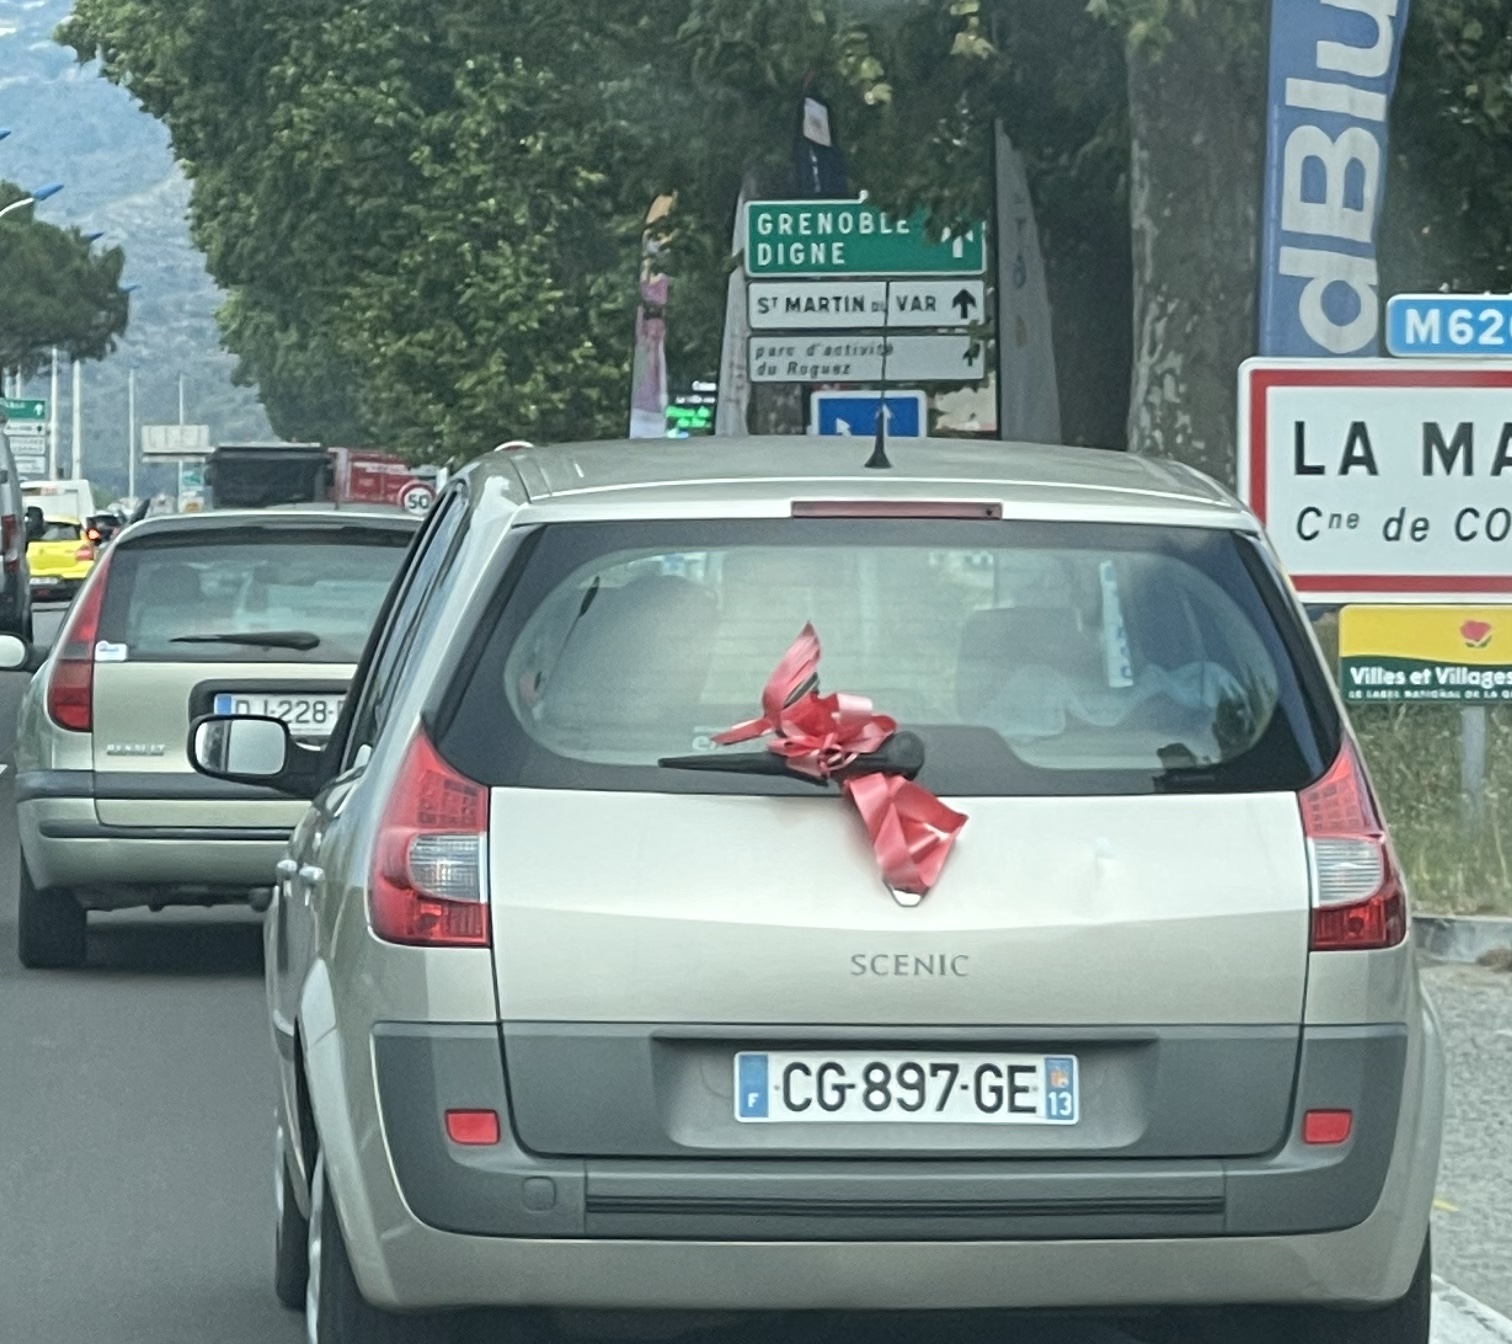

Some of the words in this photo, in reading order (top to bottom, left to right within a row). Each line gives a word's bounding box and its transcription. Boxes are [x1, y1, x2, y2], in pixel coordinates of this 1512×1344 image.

[758, 212, 910, 235] GRENOBLE
[758, 242, 846, 265] DIGNE
[785, 295, 865, 313] MARTIN
[896, 295, 937, 312] VAR
[755, 346, 795, 361] parc
[757, 362, 777, 376] du
[1294, 420, 1379, 477] LA
[409, 494, 431, 510] 50
[1296, 506, 1361, 542] Cne
[1383, 506, 1430, 543] de
[1350, 667, 1406, 685] Villes
[1409, 668, 1432, 685] et
[850, 954, 970, 977] SCENIC
[747, 1093, 759, 1108] F
[782, 1061, 1037, 1114] CG-897-GE
[1048, 1092, 1073, 1116] 13
